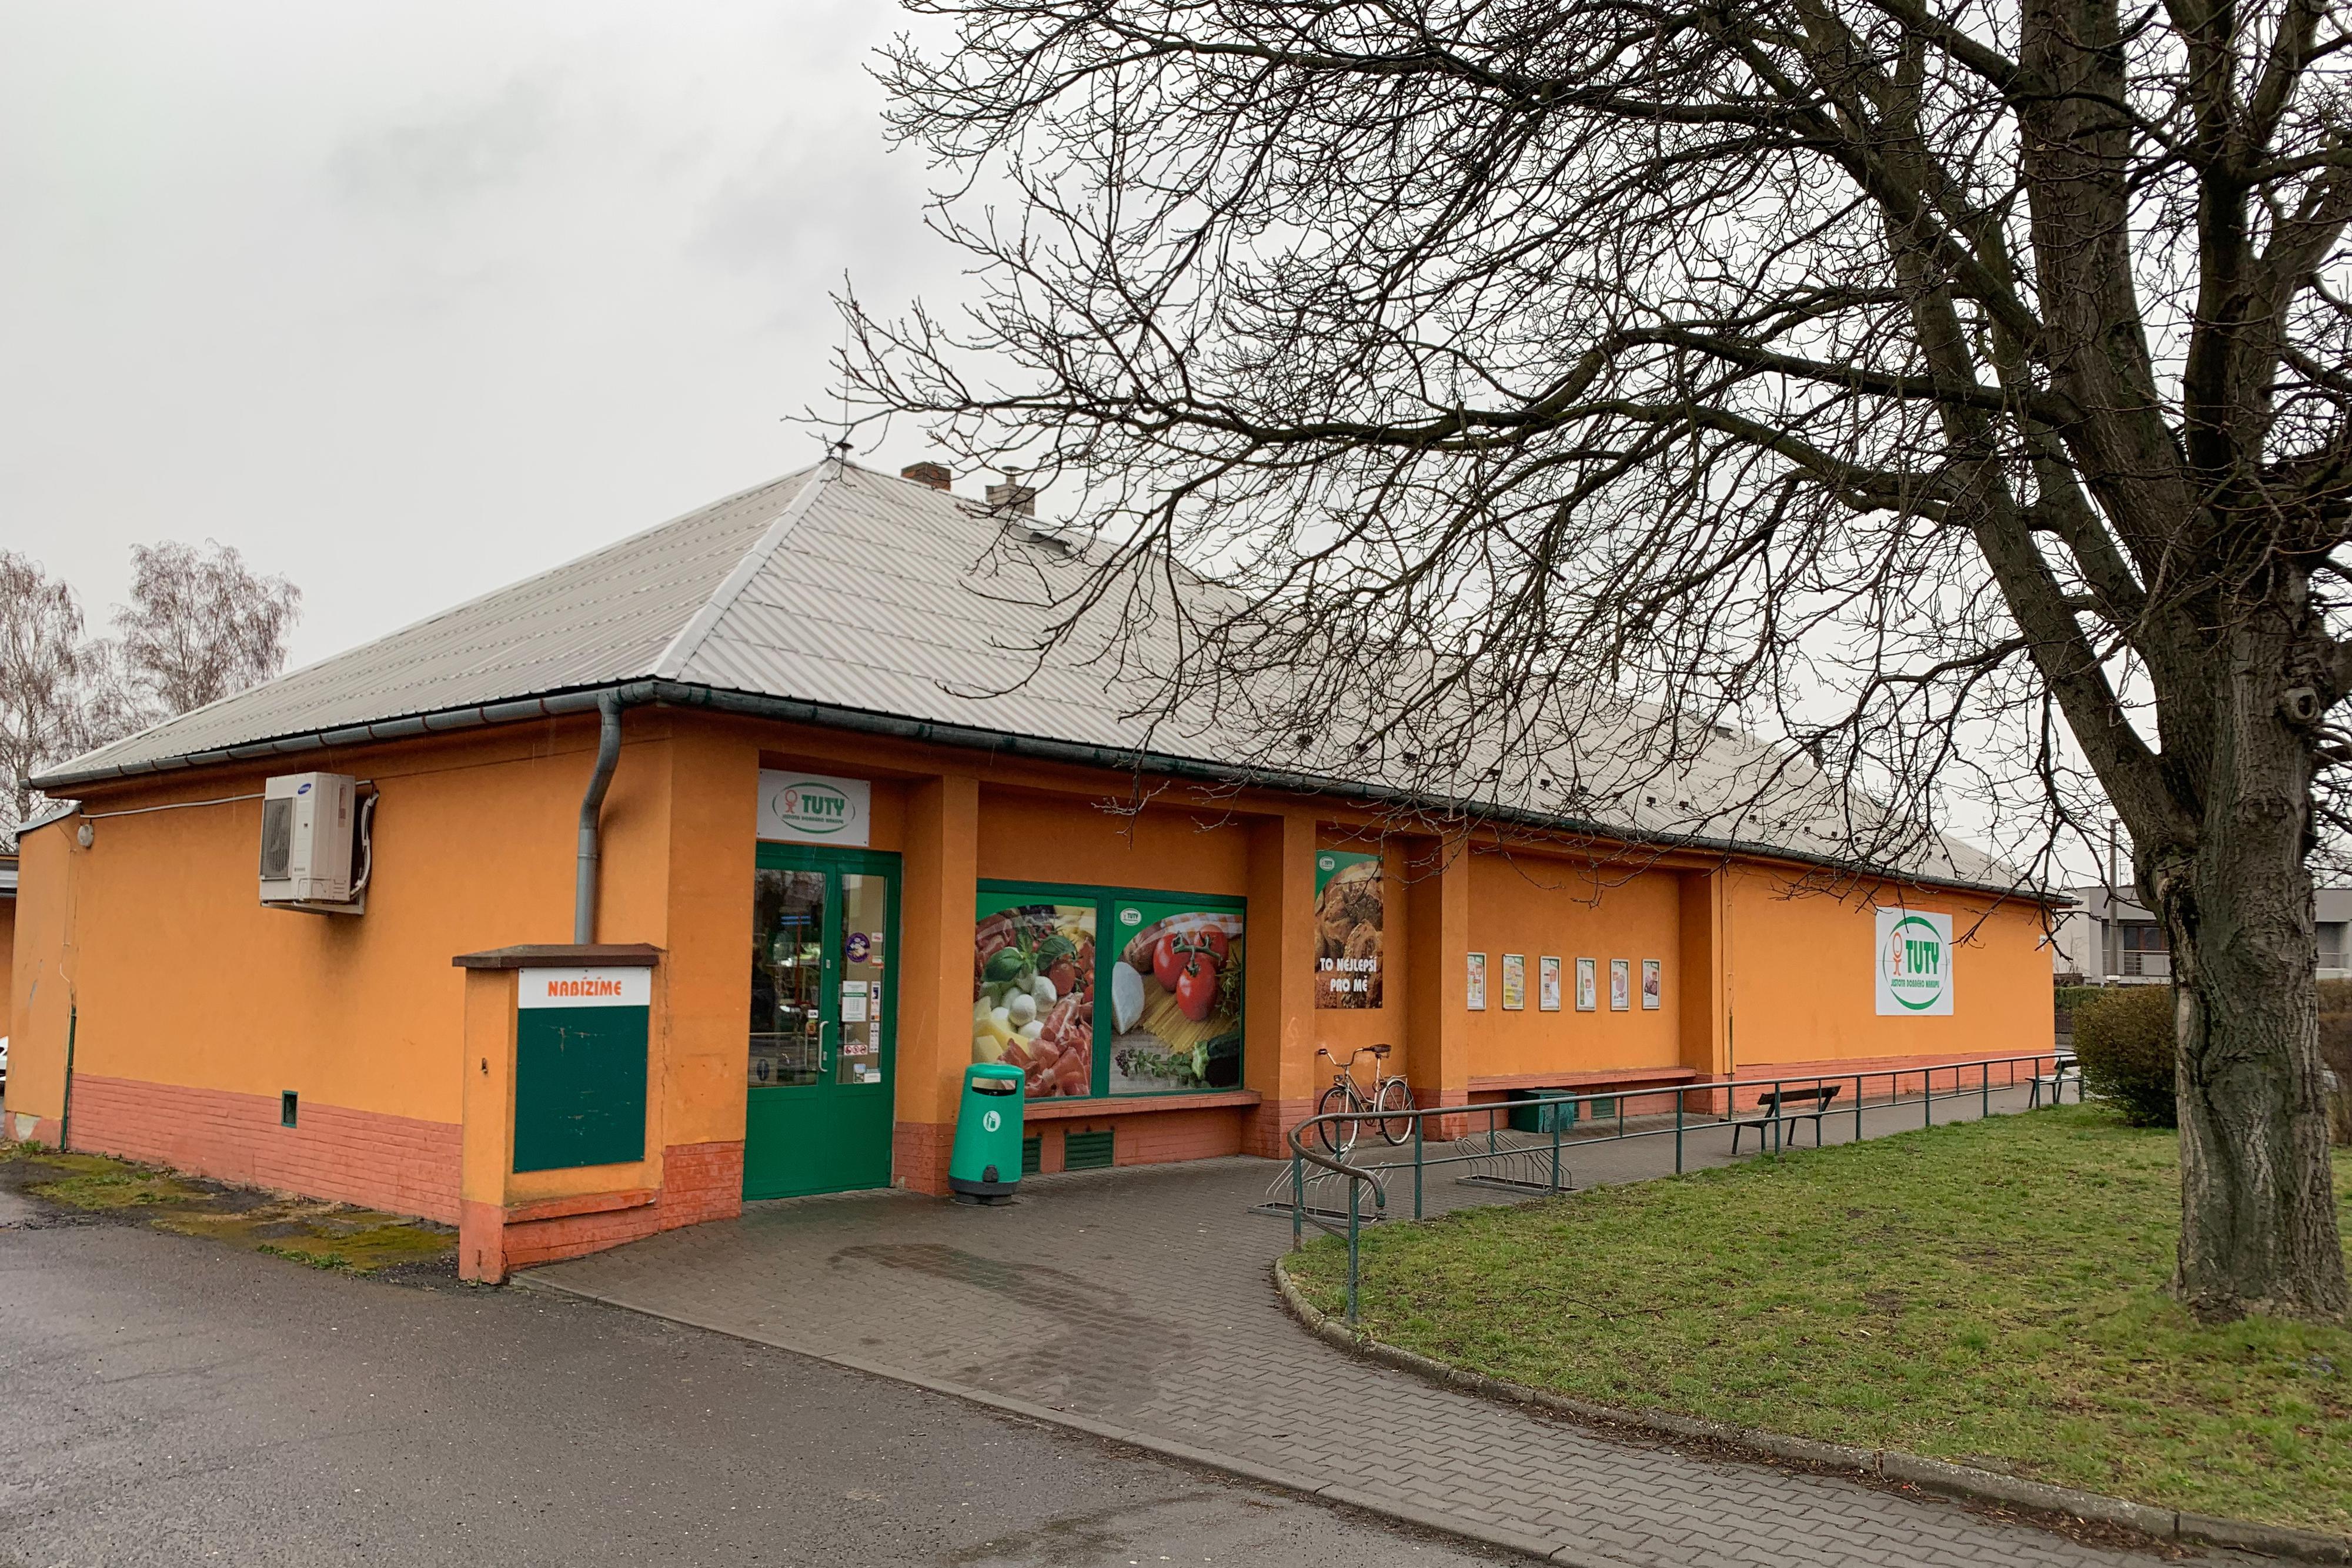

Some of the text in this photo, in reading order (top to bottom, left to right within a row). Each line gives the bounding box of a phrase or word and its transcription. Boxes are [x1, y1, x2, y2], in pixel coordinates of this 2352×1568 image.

[801, 794, 844, 816] TUTY
[1319, 955, 1377, 972] TO NEJLEPŠÍ
[1906, 940, 1939, 974] TUTY
[548, 977, 621, 997] NABÍZÍME
[1330, 975, 1368, 992] PRO MĚ
